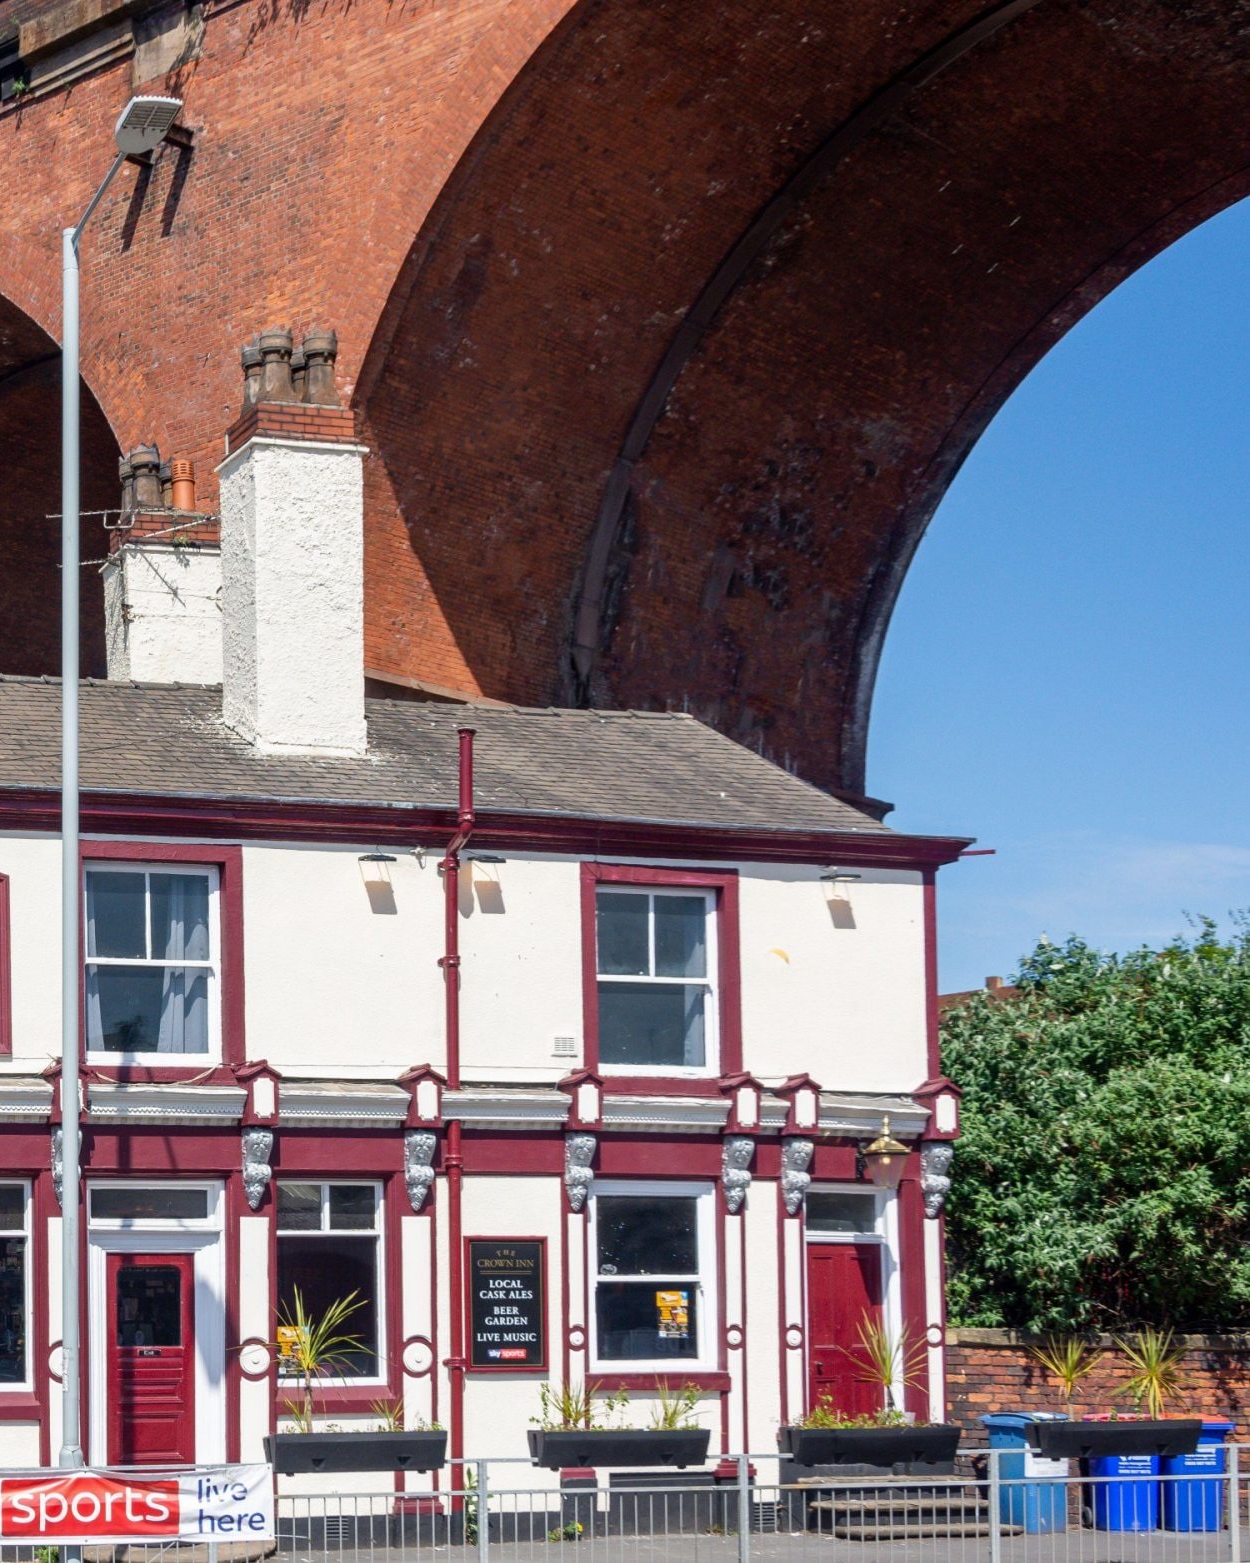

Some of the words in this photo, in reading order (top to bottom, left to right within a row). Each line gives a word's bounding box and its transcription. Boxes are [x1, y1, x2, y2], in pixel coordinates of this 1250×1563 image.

[496, 1249, 516, 1257] THE
[477, 1259, 514, 1268] CROWN
[516, 1259, 534, 1268] INN
[489, 1280, 523, 1288] LOCAL
[479, 1290, 507, 1299] CASK
[509, 1290, 533, 1299] ALES
[493, 1306, 519, 1315] BEER
[485, 1316, 528, 1325] GARDEN
[477, 1333, 500, 1342] LIVE
[503, 1333, 536, 1342] MUSIC
[197, 1479, 247, 1503] live
[11, 1486, 170, 1532] sports
[198, 1510, 265, 1533] here
